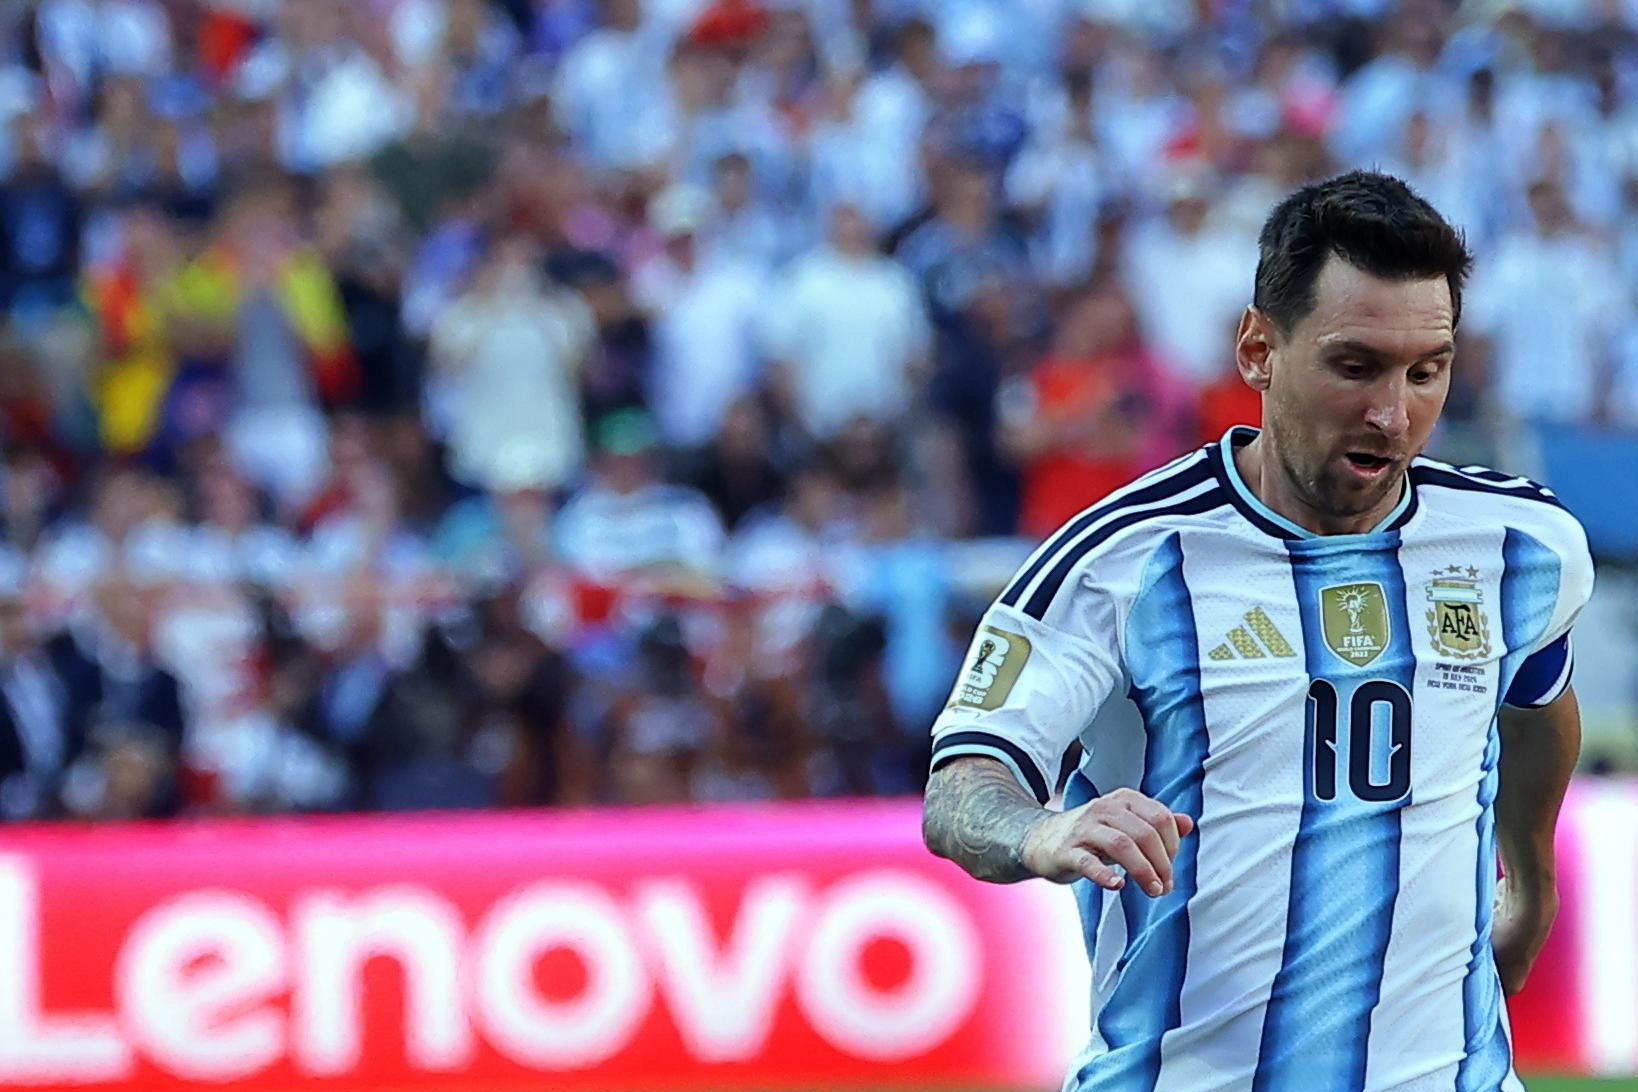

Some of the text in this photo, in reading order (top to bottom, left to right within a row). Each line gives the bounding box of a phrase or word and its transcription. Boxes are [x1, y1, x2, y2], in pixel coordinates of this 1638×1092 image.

[1343, 635, 1373, 647] FIFA
[1441, 604, 1478, 641] AFA
[1308, 679, 1413, 803] 10
[0, 852, 980, 1082] Lenovo
